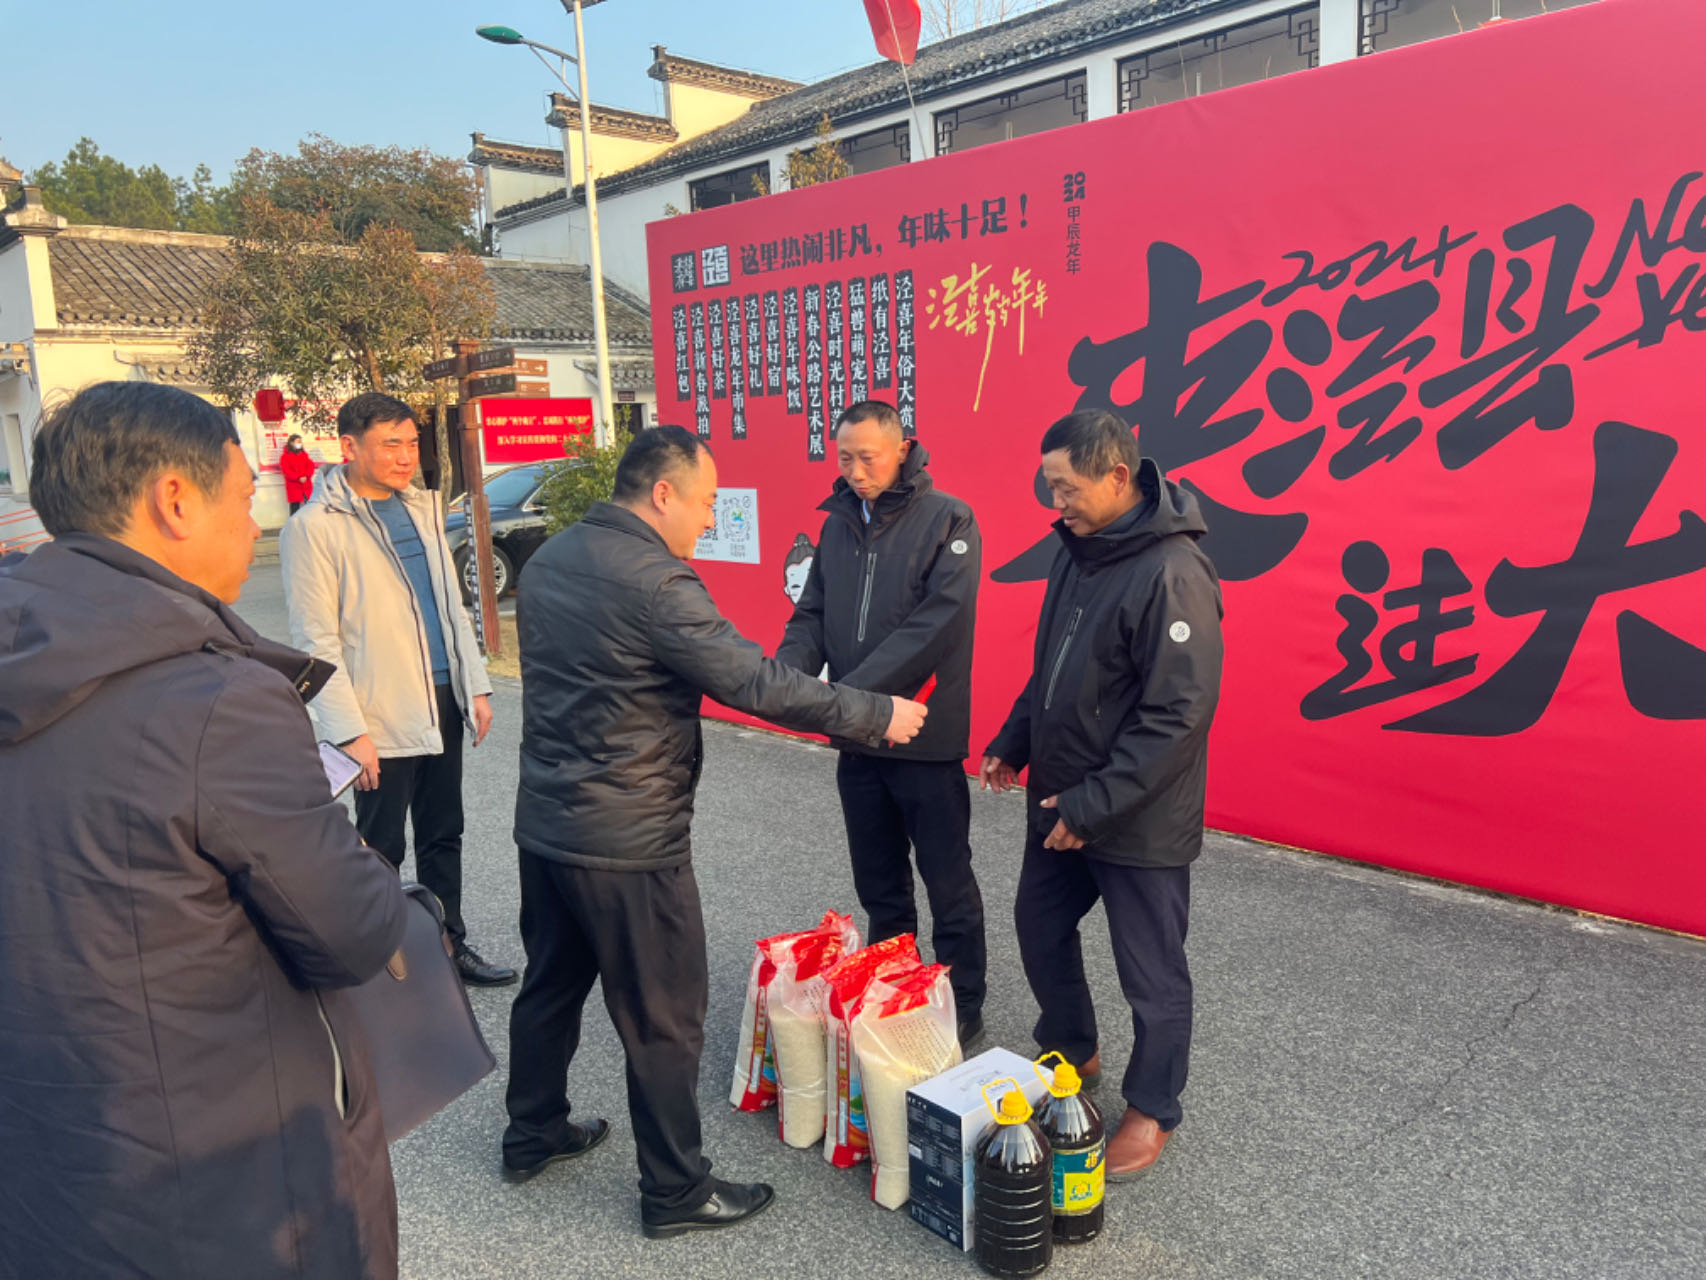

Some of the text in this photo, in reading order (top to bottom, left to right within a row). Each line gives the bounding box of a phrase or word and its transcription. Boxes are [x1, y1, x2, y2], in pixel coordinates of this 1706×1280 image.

[1066, 205, 1081, 275] 甲辰龙年
[1261, 225, 1478, 307] 2024
[745, 298, 762, 388] 泾喜好礼
[804, 289, 824, 455] 新春公路艺术展
[871, 279, 890, 381] 纸有泾喜
[895, 276, 915, 429] 泾喜年俗大赏
